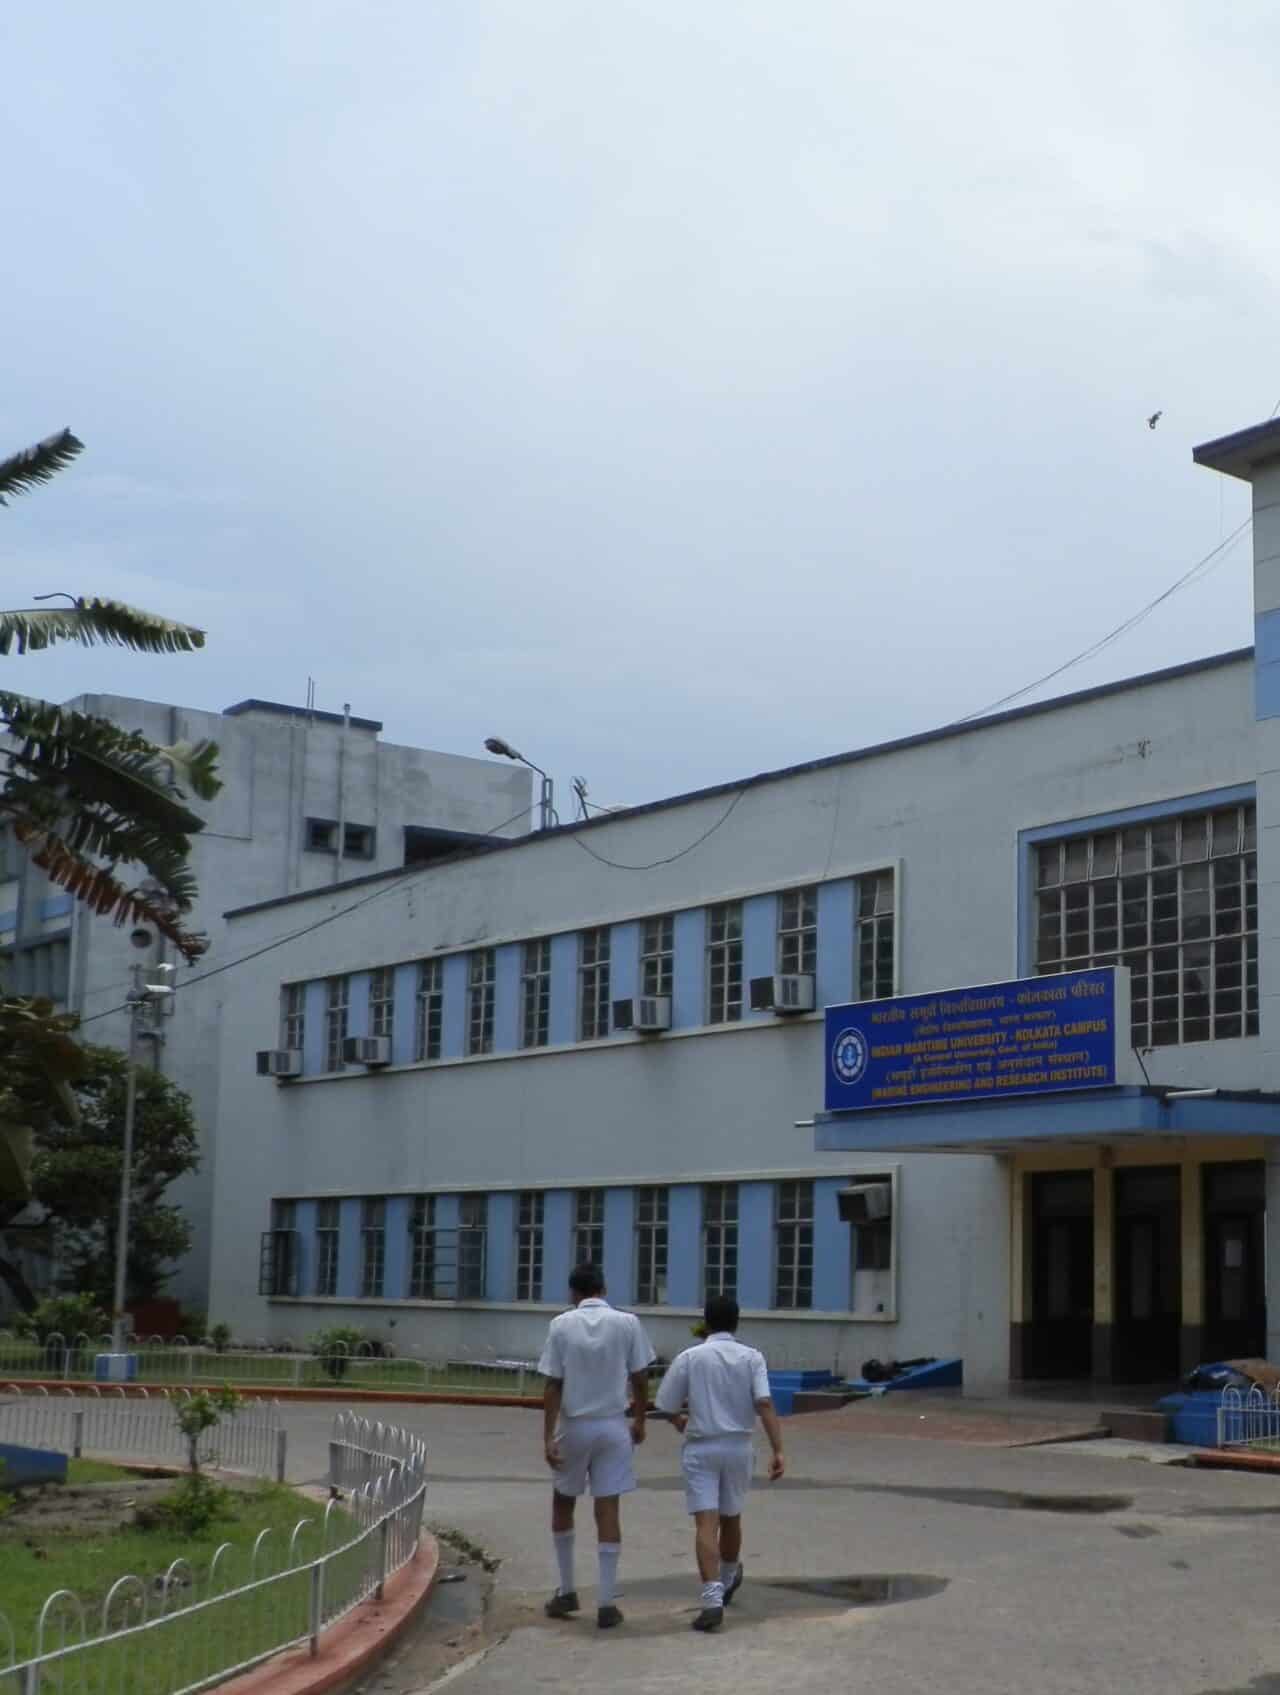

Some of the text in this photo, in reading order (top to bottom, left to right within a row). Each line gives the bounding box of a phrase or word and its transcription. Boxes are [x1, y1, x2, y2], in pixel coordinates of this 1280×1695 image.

[951, 1033, 1007, 1049] UNIVERSITY
[1015, 1025, 1062, 1042] KOLKATA
[1063, 1019, 1107, 1036] CAMPUS
[974, 1077, 994, 1089] AND
[995, 1071, 1049, 1088] RESEARCH
